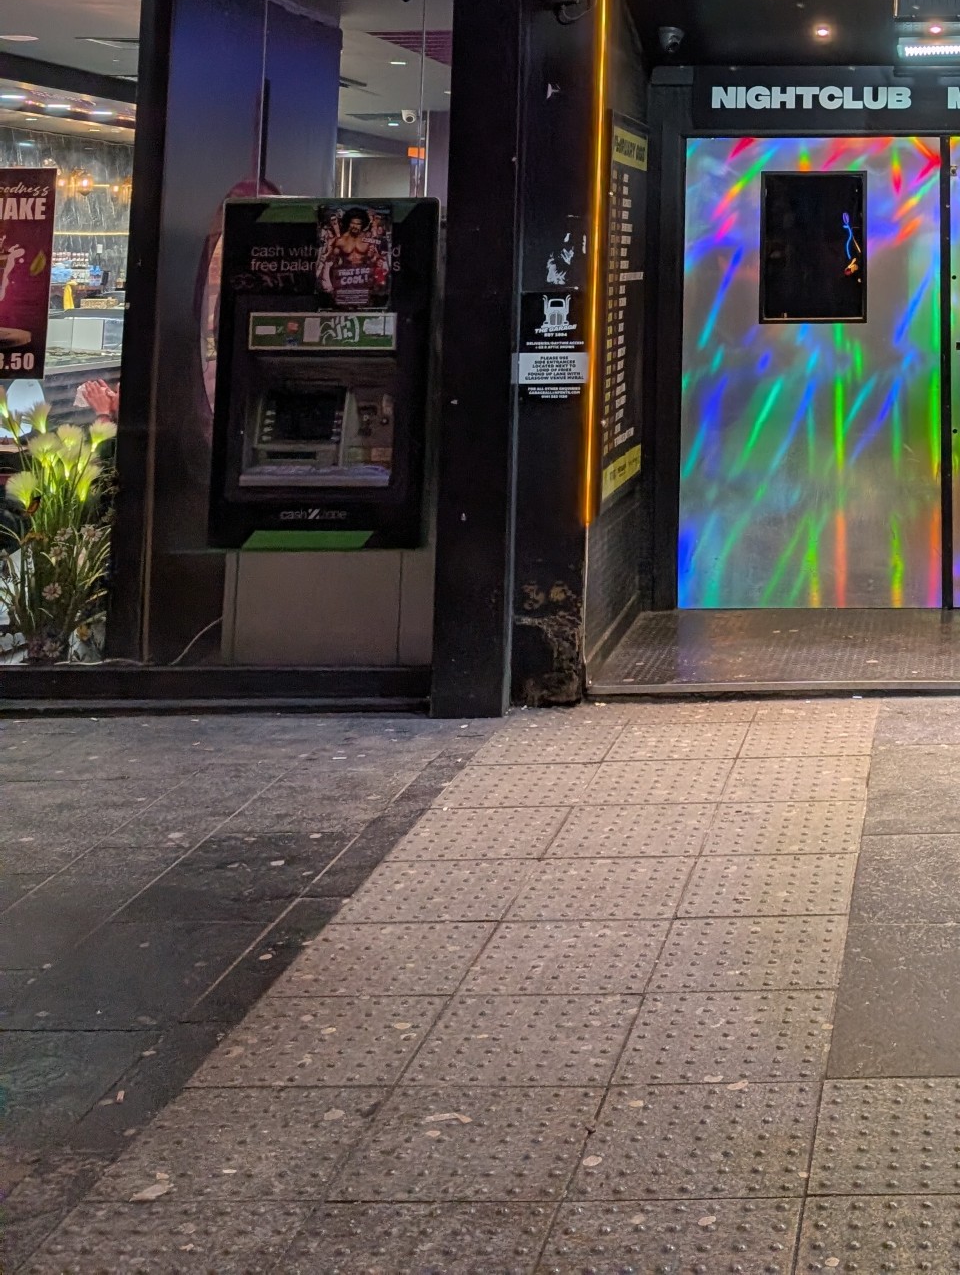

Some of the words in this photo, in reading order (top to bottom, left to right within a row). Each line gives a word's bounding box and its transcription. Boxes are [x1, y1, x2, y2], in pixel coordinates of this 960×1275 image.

[711, 86, 912, 110] NIGHTCLUB
[251, 245, 285, 257] cash
[250, 260, 278, 271] free
[549, 324, 578, 332] GARAGE
